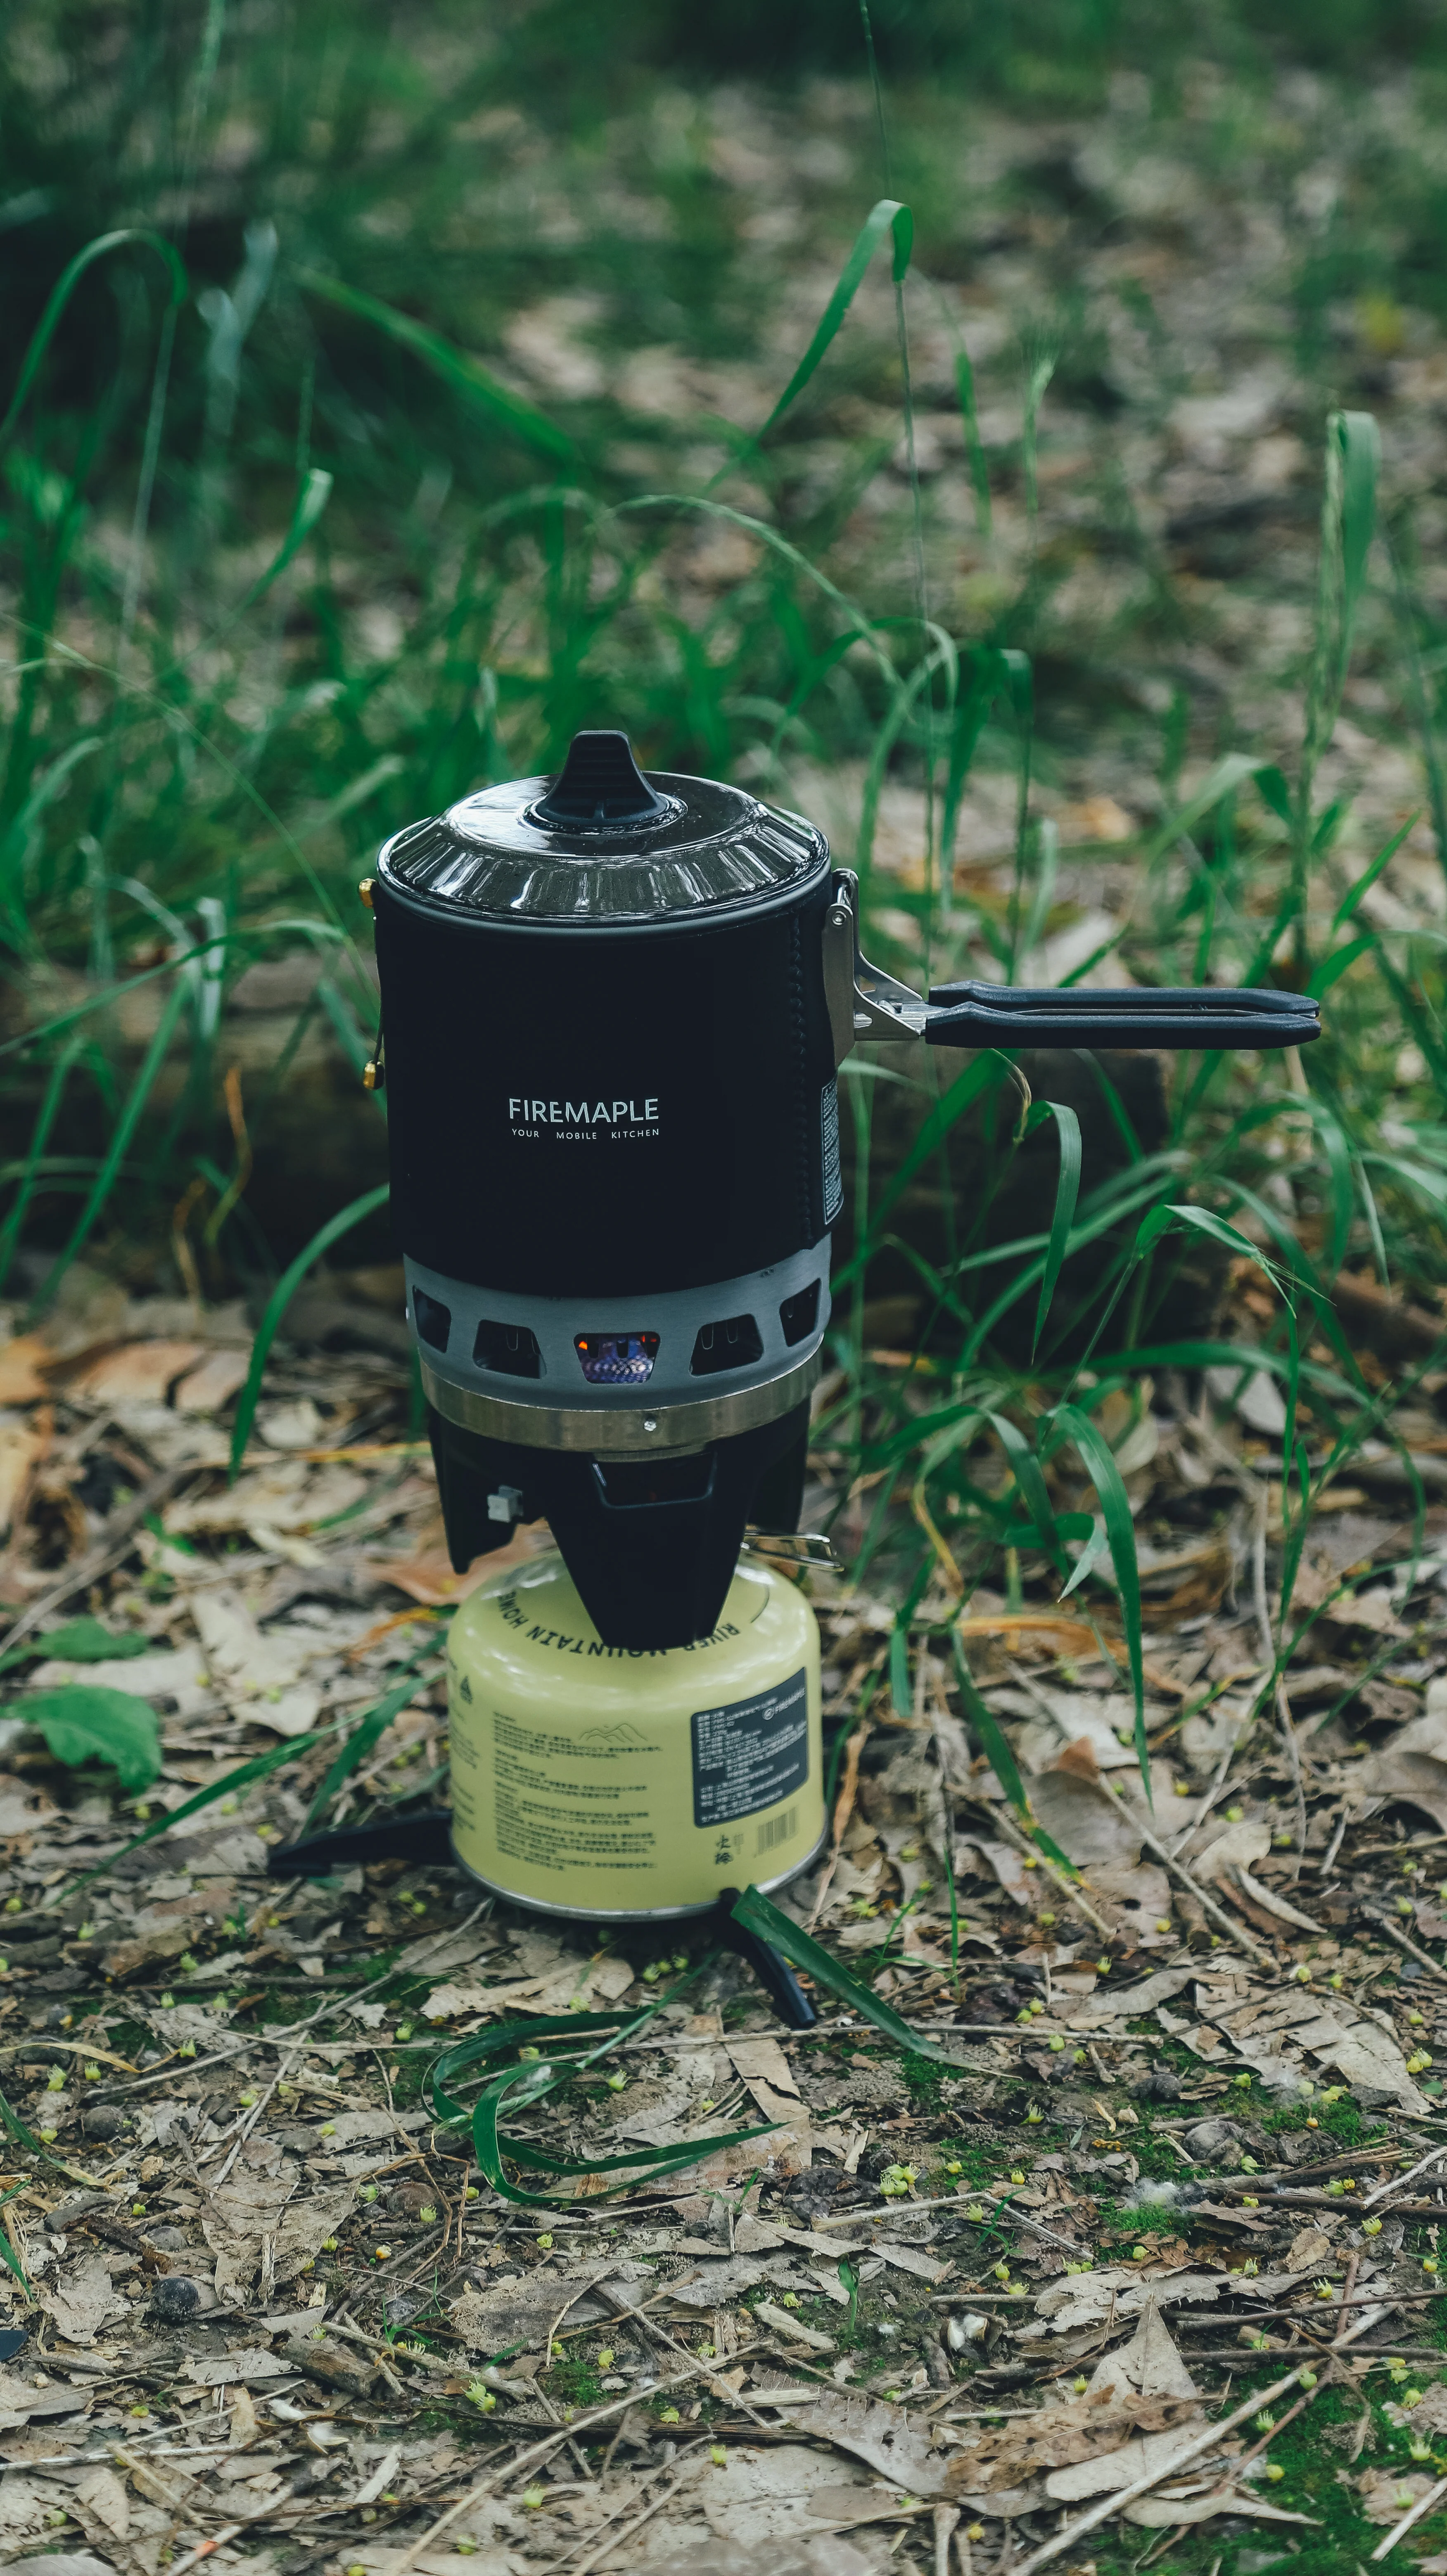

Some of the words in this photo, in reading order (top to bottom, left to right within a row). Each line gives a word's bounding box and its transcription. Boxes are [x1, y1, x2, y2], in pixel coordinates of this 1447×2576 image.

[510, 1099, 659, 1123] FIREMAPLE
[512, 1129, 539, 1137] YOUR
[612, 1129, 658, 1138] KITCHEN
